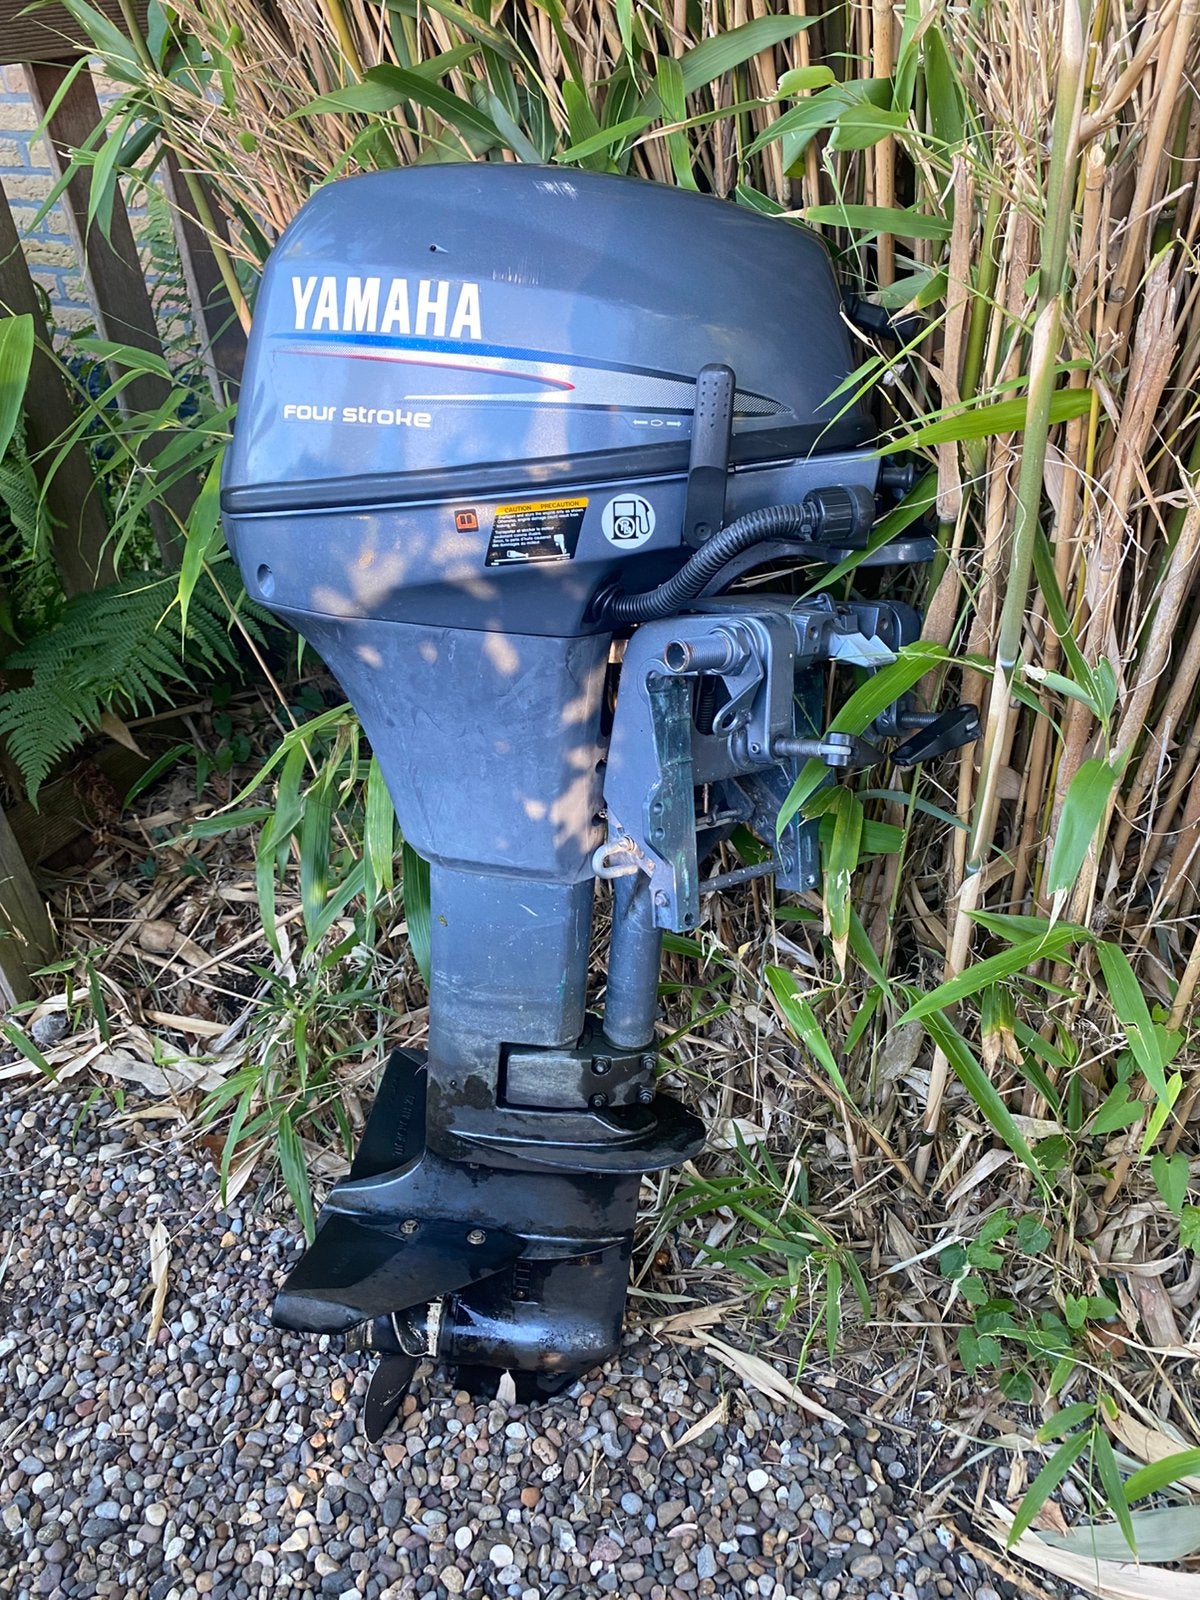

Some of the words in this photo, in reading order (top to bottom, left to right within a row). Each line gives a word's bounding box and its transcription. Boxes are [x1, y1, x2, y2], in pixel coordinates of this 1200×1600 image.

[292, 276, 482, 340] YAMAHA
[504, 505, 532, 513] CAUTION
[540, 501, 579, 509] PRECAUTION
